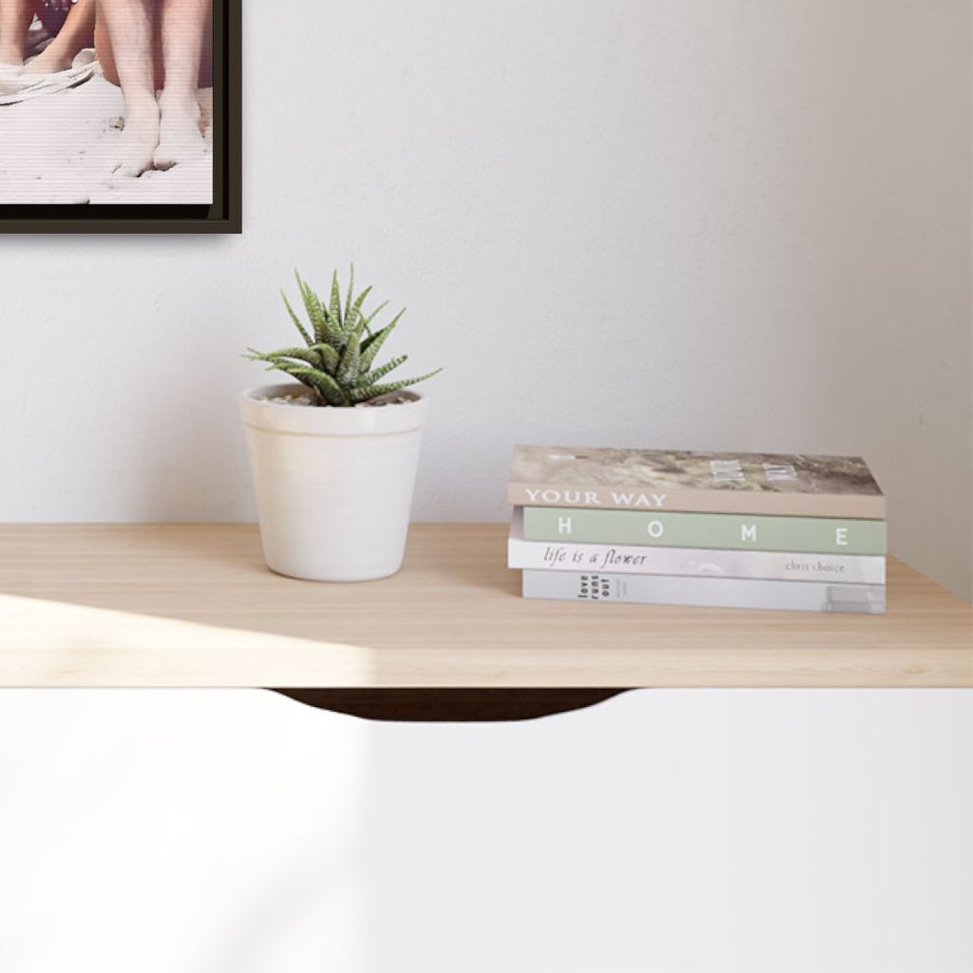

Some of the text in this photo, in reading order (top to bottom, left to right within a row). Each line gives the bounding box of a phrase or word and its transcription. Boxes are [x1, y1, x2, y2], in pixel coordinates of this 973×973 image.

[525, 488, 668, 507] YOUR WAY
[543, 546, 649, 569] life is a flower
[785, 561, 846, 574] chris choice
[578, 575, 589, 598] love
[591, 575, 600, 600] runs
[600, 578, 610, 597] out
